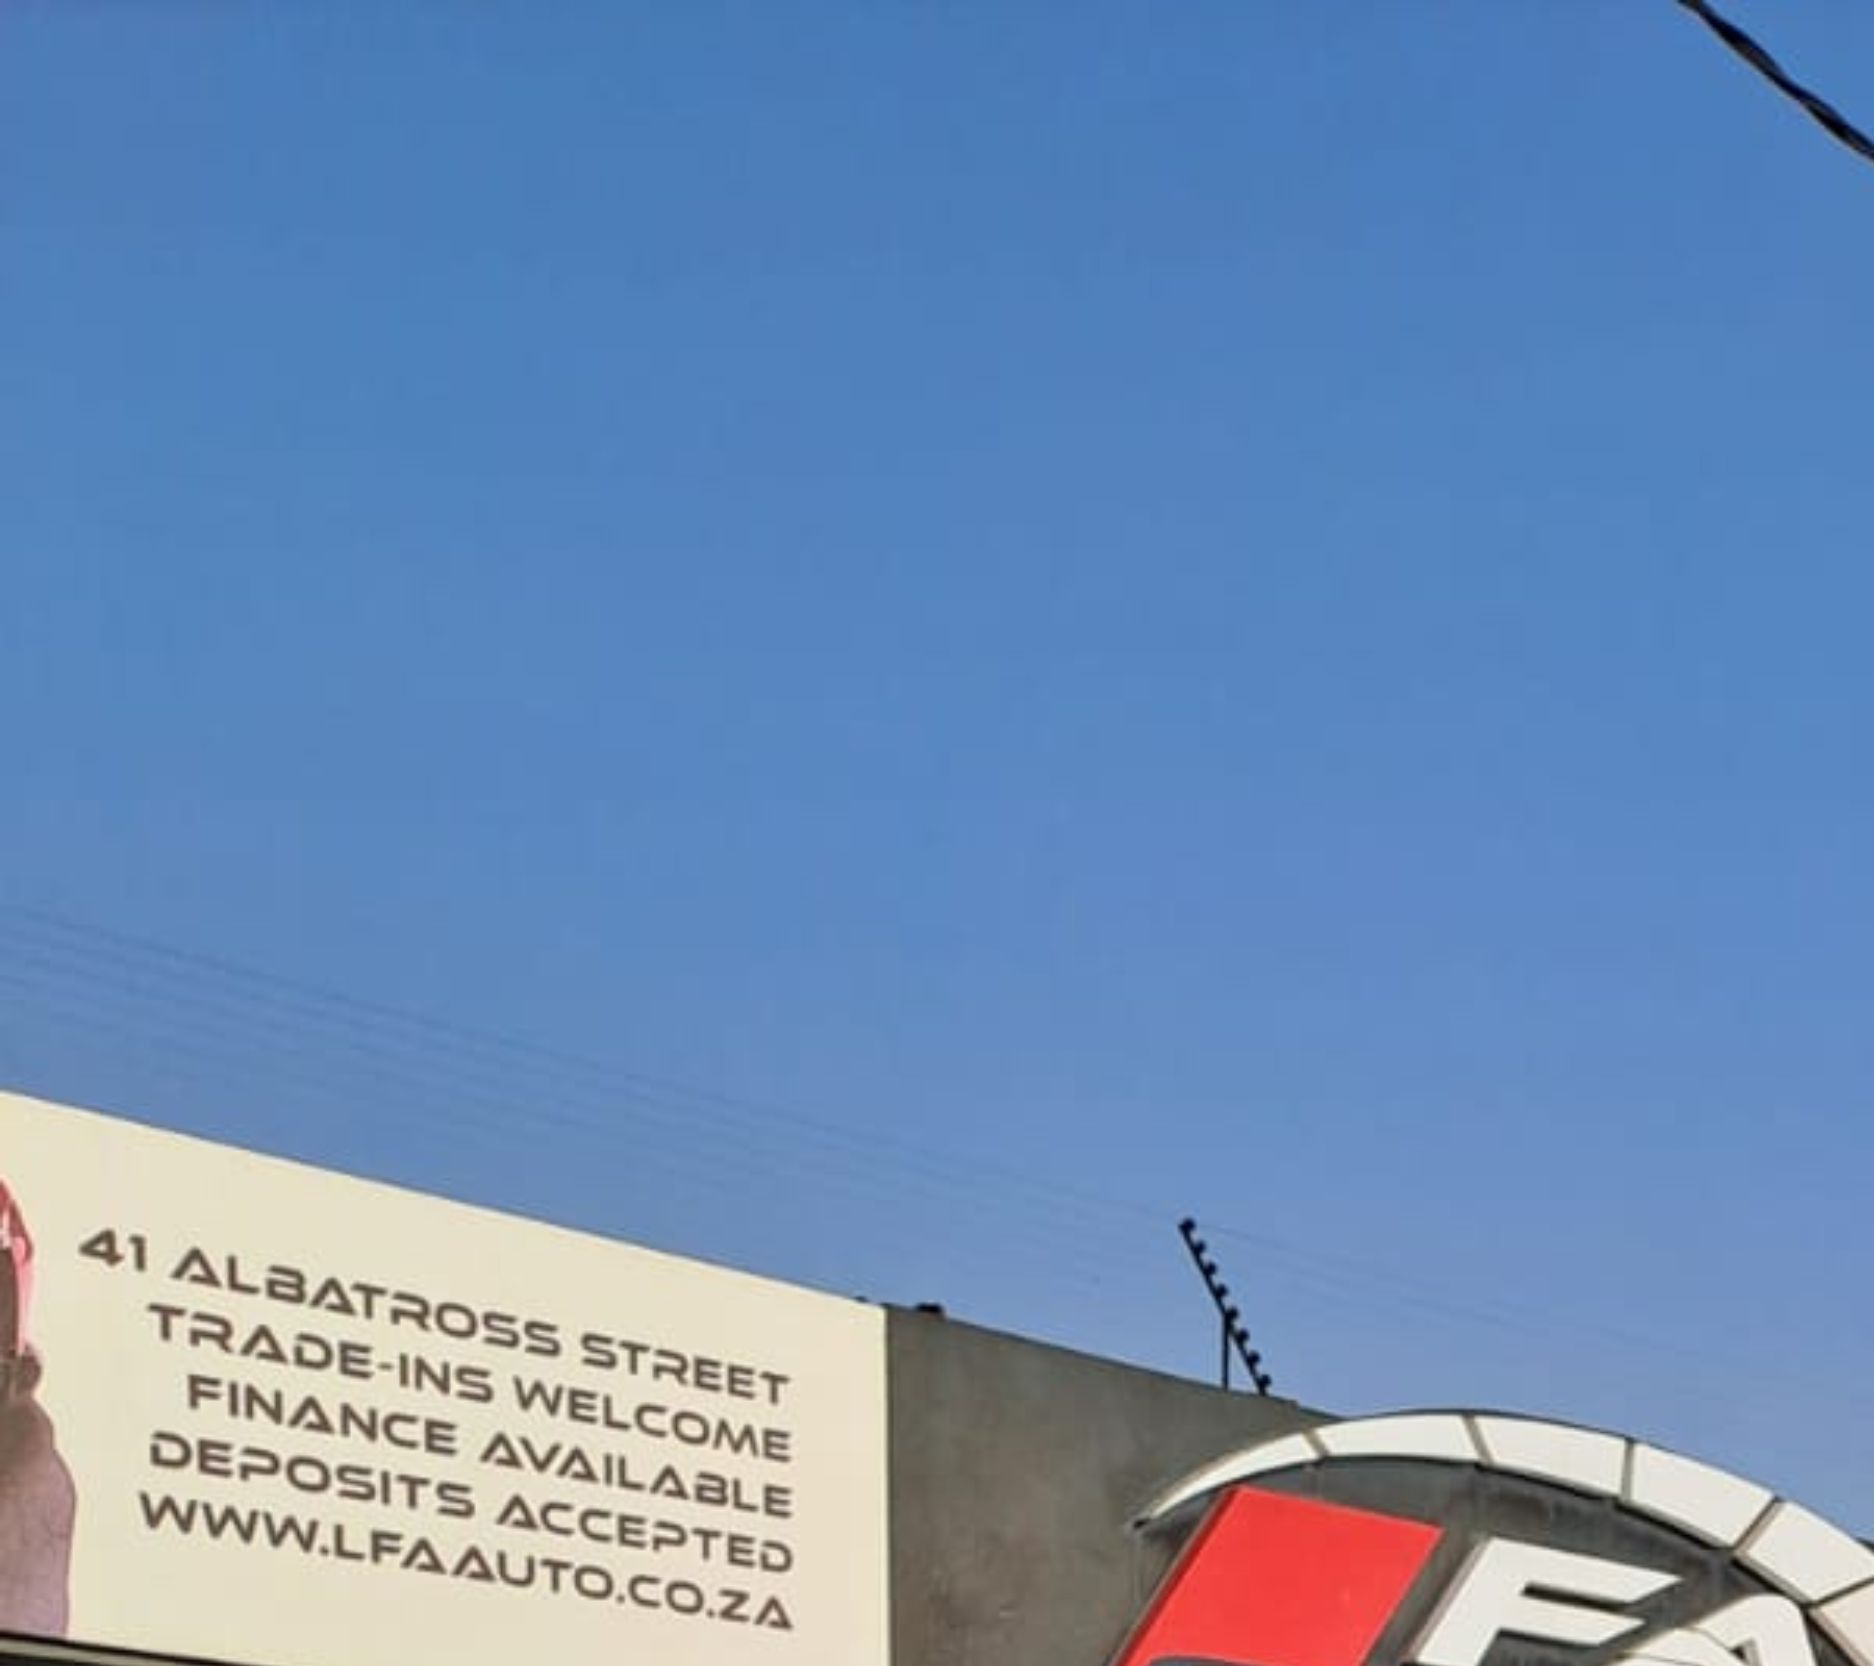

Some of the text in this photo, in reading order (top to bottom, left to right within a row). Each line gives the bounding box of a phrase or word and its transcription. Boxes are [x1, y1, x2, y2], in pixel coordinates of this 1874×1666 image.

[79, 1229, 790, 1405] 41 ALBATROSS STREET
[146, 1303, 791, 1463] TRADE-INS WELCOME
[150, 1430, 793, 1573] DEPOSITS ACCEPTED
[187, 1374, 793, 1519] FINANCE AVAILABLE
[138, 1490, 794, 1631] WWW.LFAAUTO.CO.ZA
